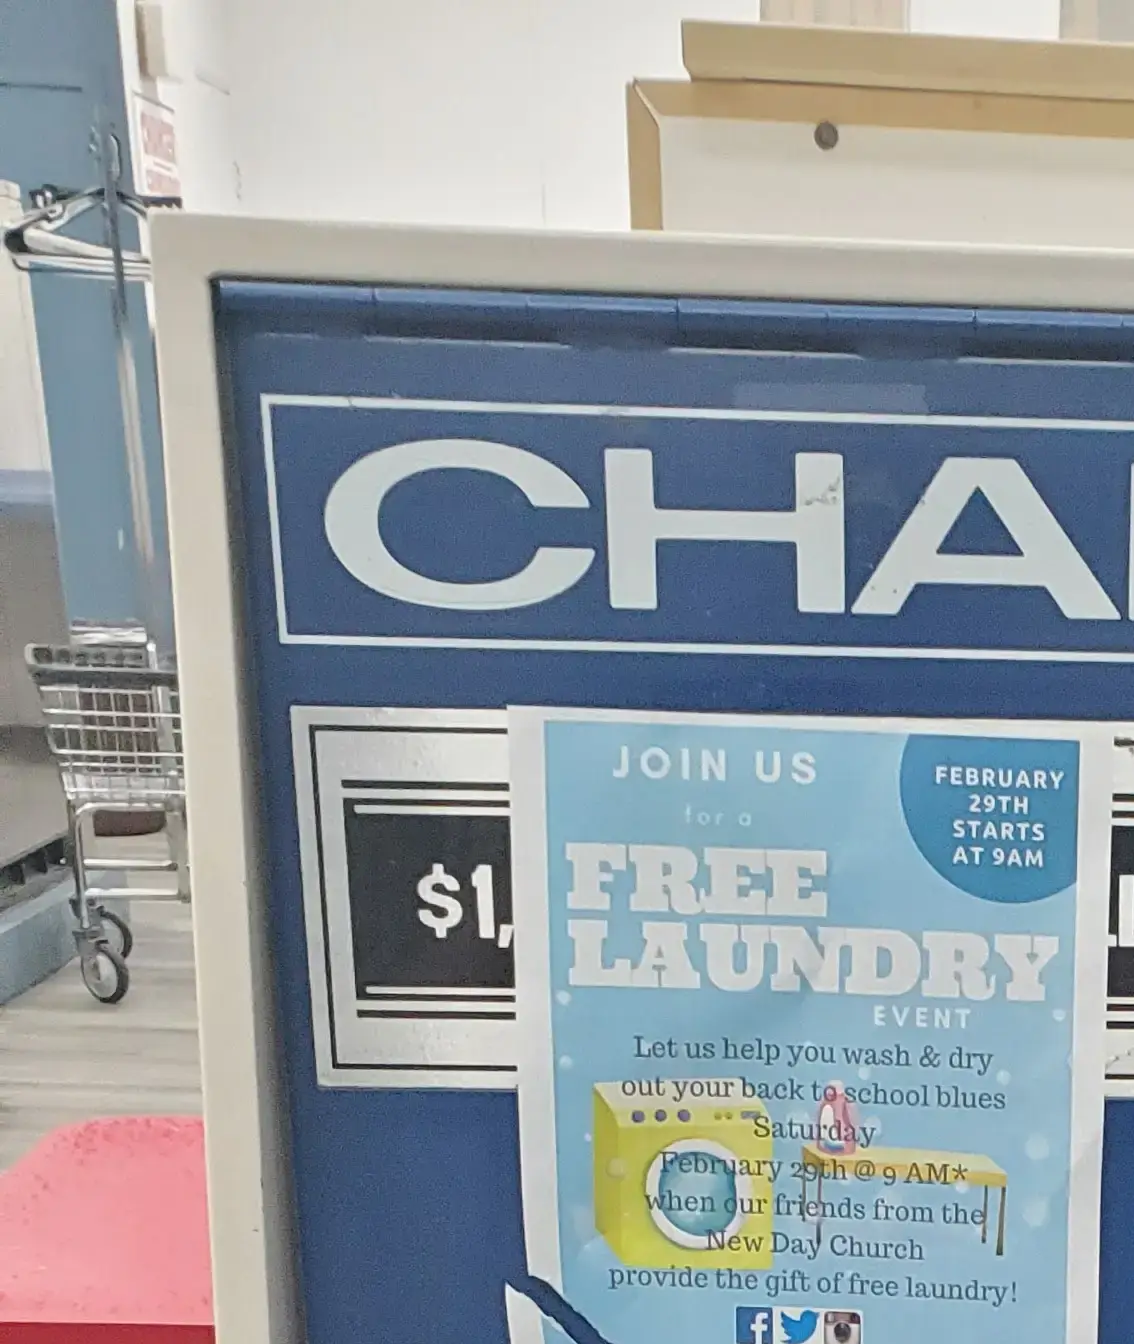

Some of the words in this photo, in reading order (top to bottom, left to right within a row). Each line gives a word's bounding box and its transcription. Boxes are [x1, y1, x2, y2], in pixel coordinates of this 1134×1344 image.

[612, 745, 727, 782] JOIN
[755, 751, 817, 785] US
[935, 766, 1065, 791] FEBRUARY
[684, 804, 724, 827] for
[738, 812, 753, 827] a
[968, 795, 1030, 815] 29TH
[952, 819, 1046, 842] STARTS
[952, 846, 986, 866] AT
[993, 847, 1045, 869] 9AM
[565, 842, 828, 917] FREE
[417, 863, 516, 948] $1,
[567, 919, 1060, 1001] LAUNDRY
[873, 1005, 974, 1030] EVENT
[633, 1035, 679, 1061] Let
[683, 1042, 716, 1061] us
[722, 1038, 781, 1068] help
[787, 1044, 837, 1069] you
[842, 1042, 912, 1068] wash
[918, 1046, 941, 1069] &
[948, 1046, 994, 1075] dry
[620, 1078, 667, 1098] out
[671, 1080, 735, 1105] your
[740, 1077, 804, 1102] back
[810, 1082, 837, 1104] to
[843, 1083, 929, 1108] school
[935, 1086, 1006, 1111] blues
[752, 1115, 877, 1149] Saturday
[659, 1151, 783, 1183] February
[789, 1158, 848, 1187] 29th
[852, 1160, 876, 1182] @
[882, 1166, 896, 1188] 9
[644, 1190, 717, 1214] when
[723, 1196, 769, 1216] our
[774, 1192, 866, 1220] friends
[872, 1199, 936, 1224] from
[940, 1204, 985, 1226] the
[705, 1229, 765, 1253] New
[769, 1232, 822, 1261] Day
[829, 1235, 924, 1261] Church
[607, 1265, 709, 1293] provide
[715, 1268, 759, 1291] the
[765, 1270, 811, 1298] gift
[817, 1272, 844, 1295] of
[847, 1273, 899, 1298] free
[904, 1277, 1017, 1307] laundry!
